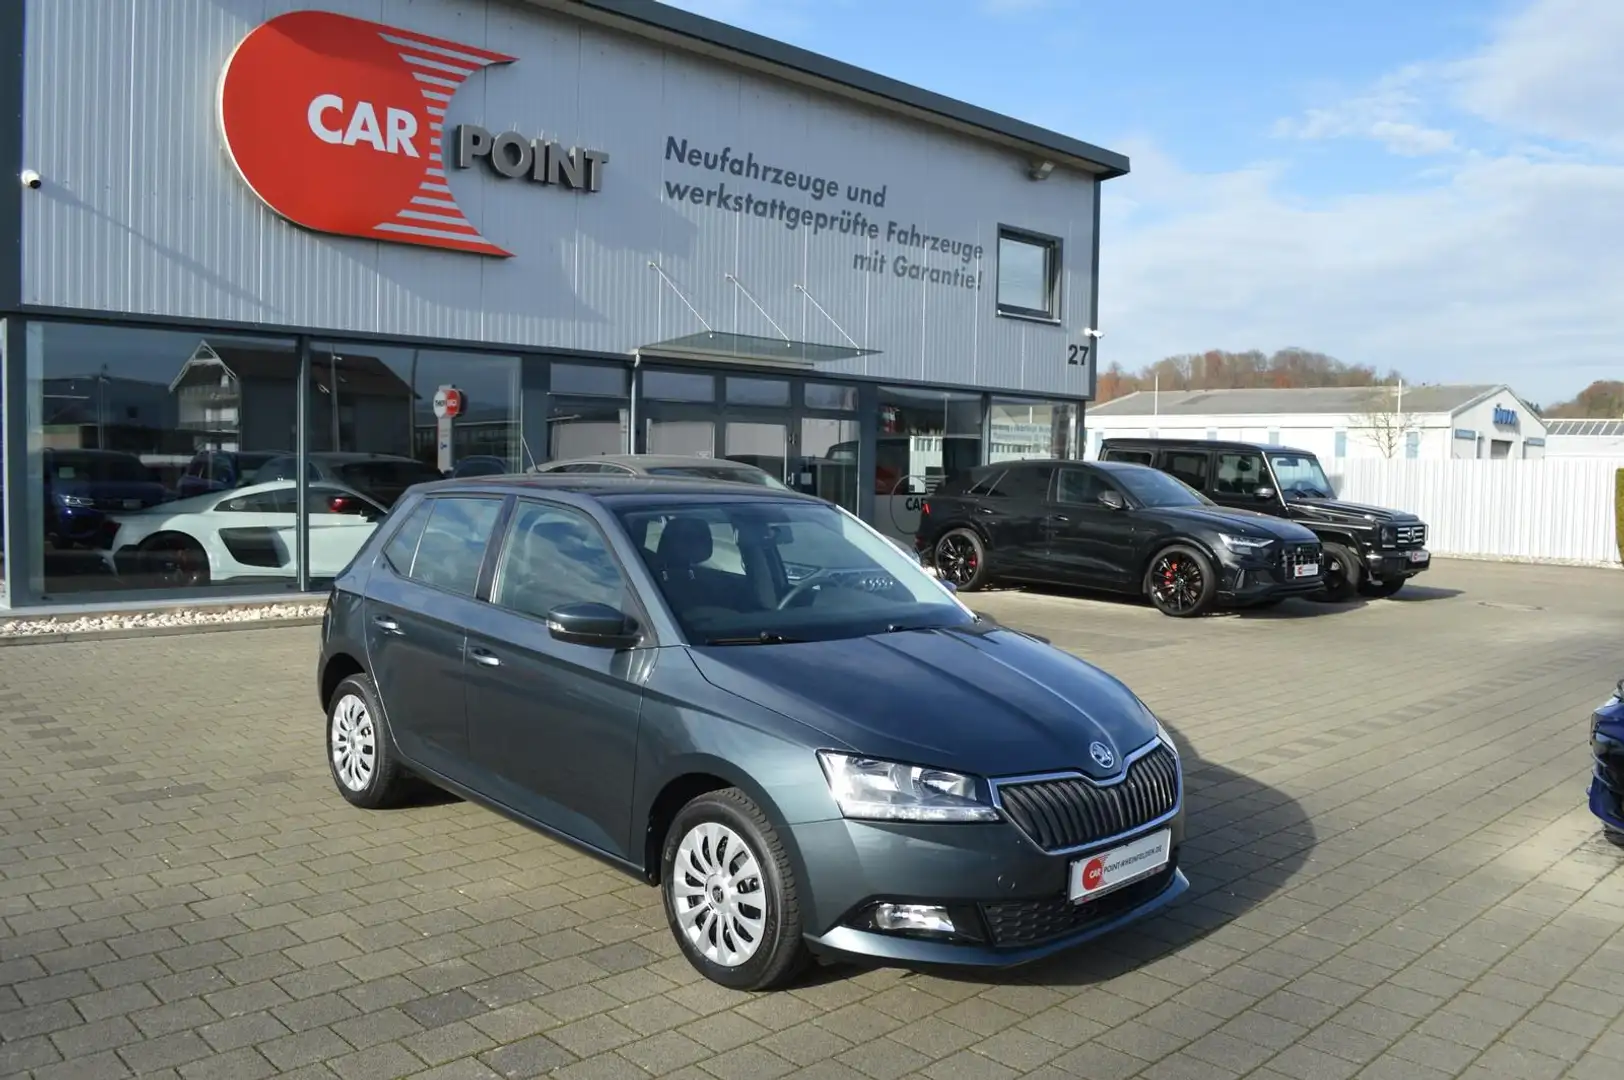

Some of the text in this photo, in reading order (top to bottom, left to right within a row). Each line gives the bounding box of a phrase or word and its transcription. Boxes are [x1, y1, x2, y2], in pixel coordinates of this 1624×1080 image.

[307, 94, 420, 159] CAR
[455, 123, 610, 193] POINT
[665, 136, 887, 208] Neufahrzeuge und
[664, 180, 984, 263] werkstattgeprüfte Fahrzeuge
[852, 250, 983, 291] mit Garantie!
[1068, 344, 1089, 366] 27
